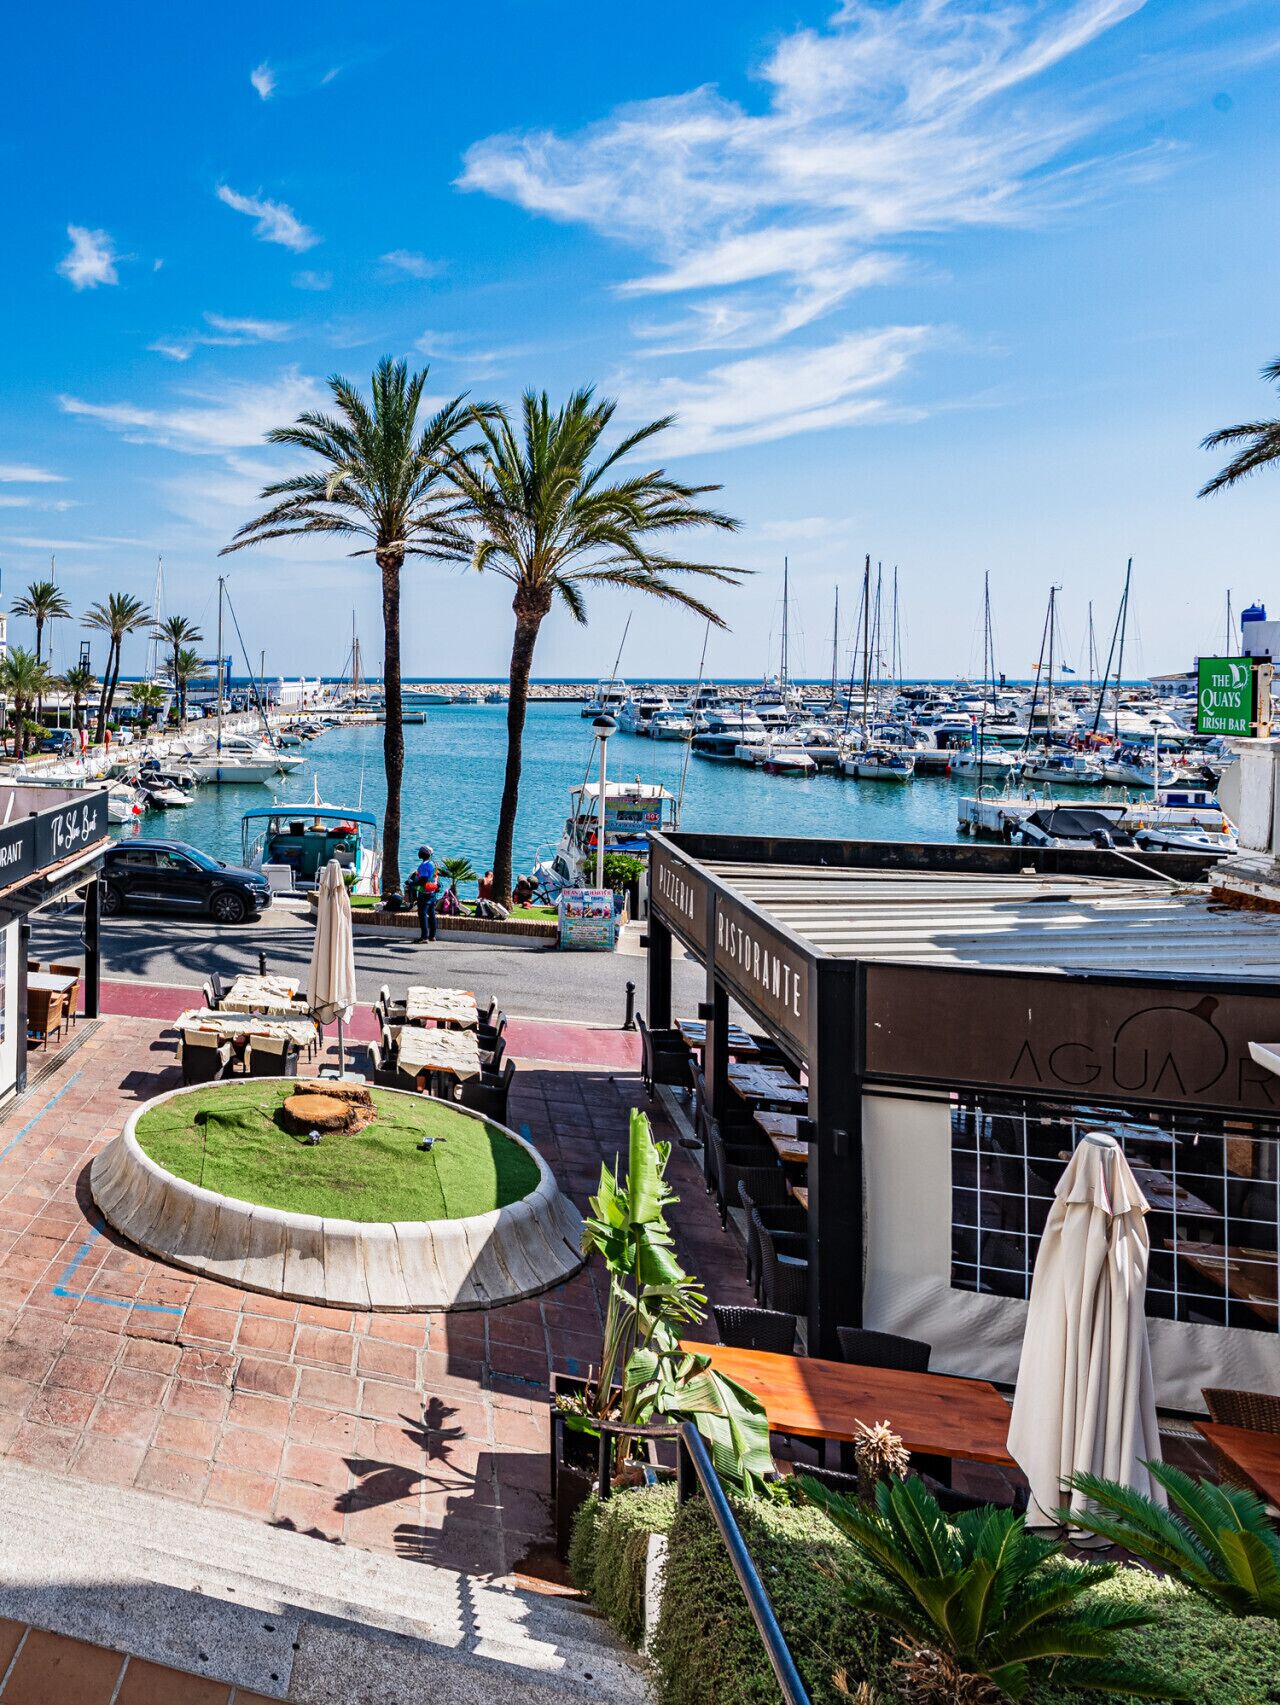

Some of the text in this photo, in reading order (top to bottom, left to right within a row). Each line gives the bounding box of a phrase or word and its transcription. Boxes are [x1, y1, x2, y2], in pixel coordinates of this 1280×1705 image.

[1211, 674, 1230, 687] THE
[1200, 688, 1241, 717] QUAYS
[1202, 717, 1246, 731] IRISH BAR
[658, 864, 694, 920] PIZZERIA
[718, 912, 801, 1017] RISTORANTE
